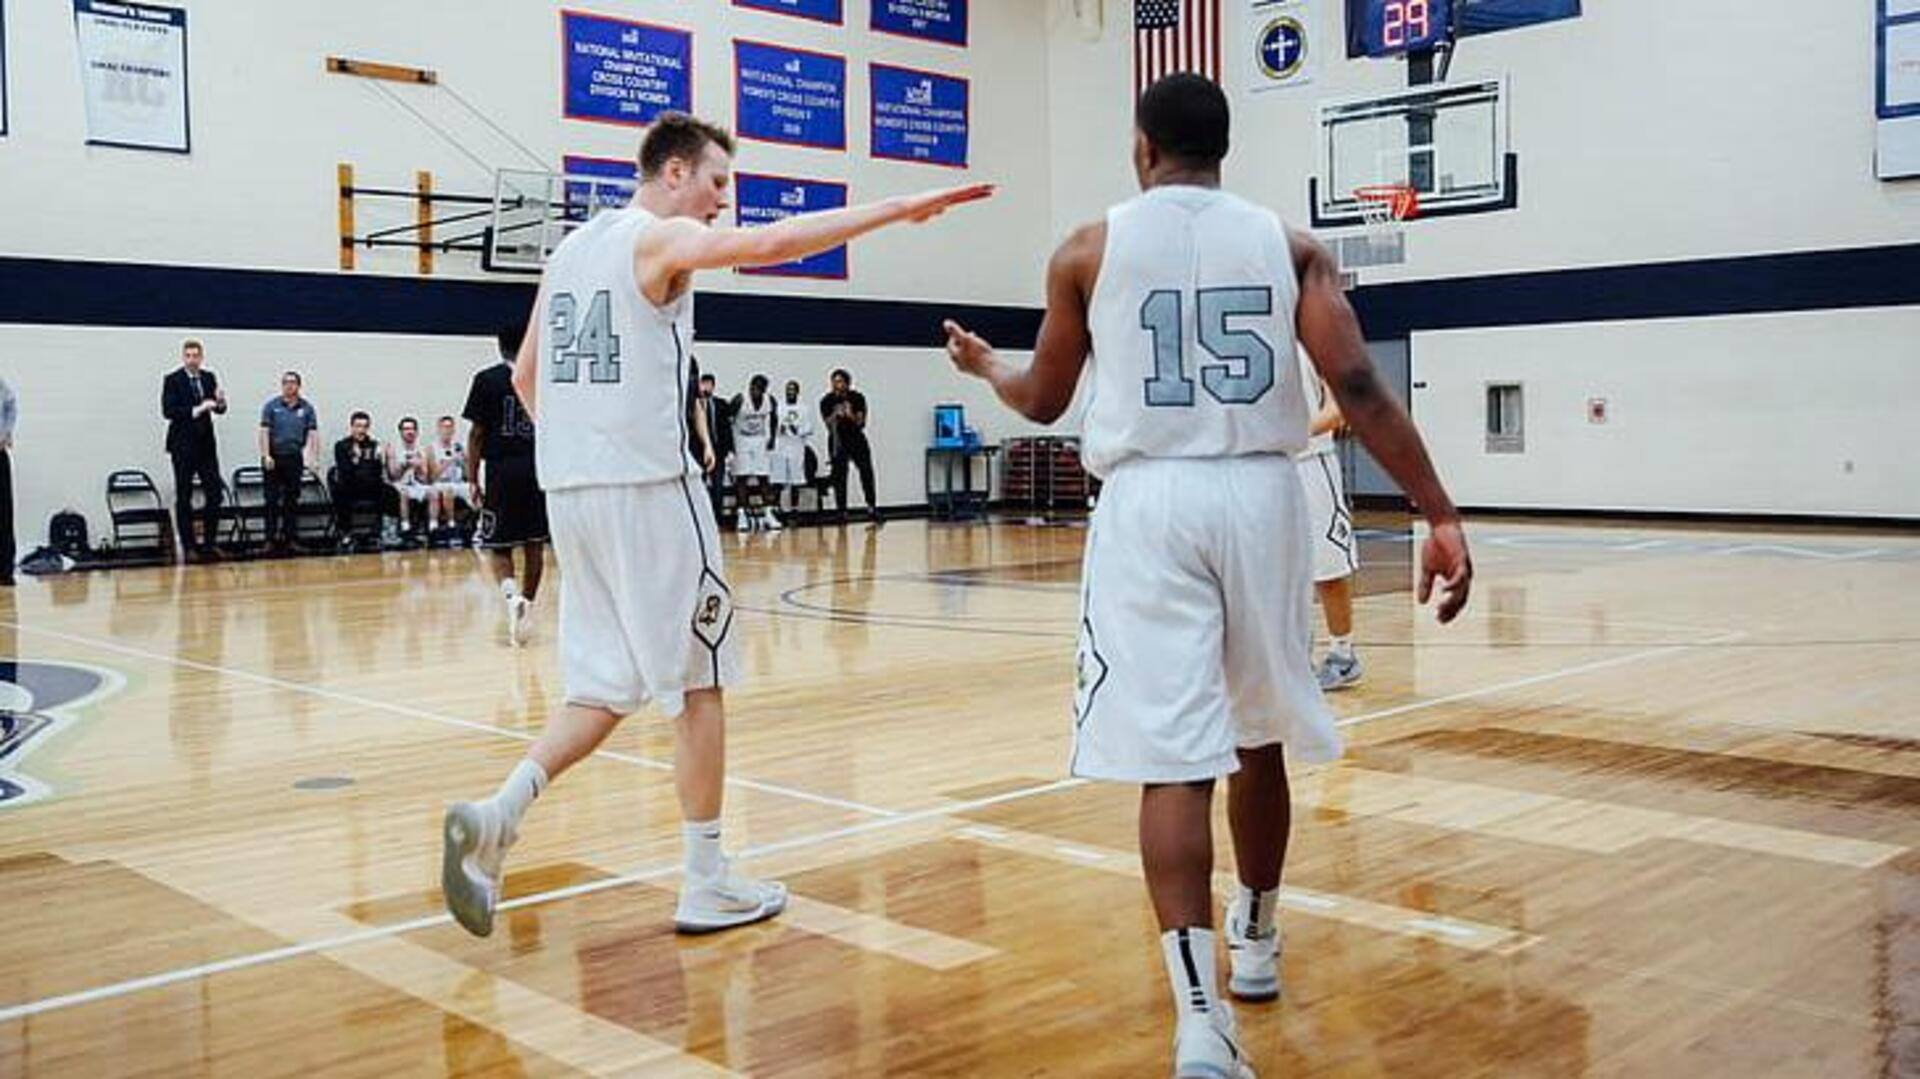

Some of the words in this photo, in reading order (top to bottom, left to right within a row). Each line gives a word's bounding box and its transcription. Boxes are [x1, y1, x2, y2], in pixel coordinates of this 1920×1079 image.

[1384, 0, 1428, 47] 29
[549, 290, 621, 383] 24
[1140, 286, 1274, 407] 15
